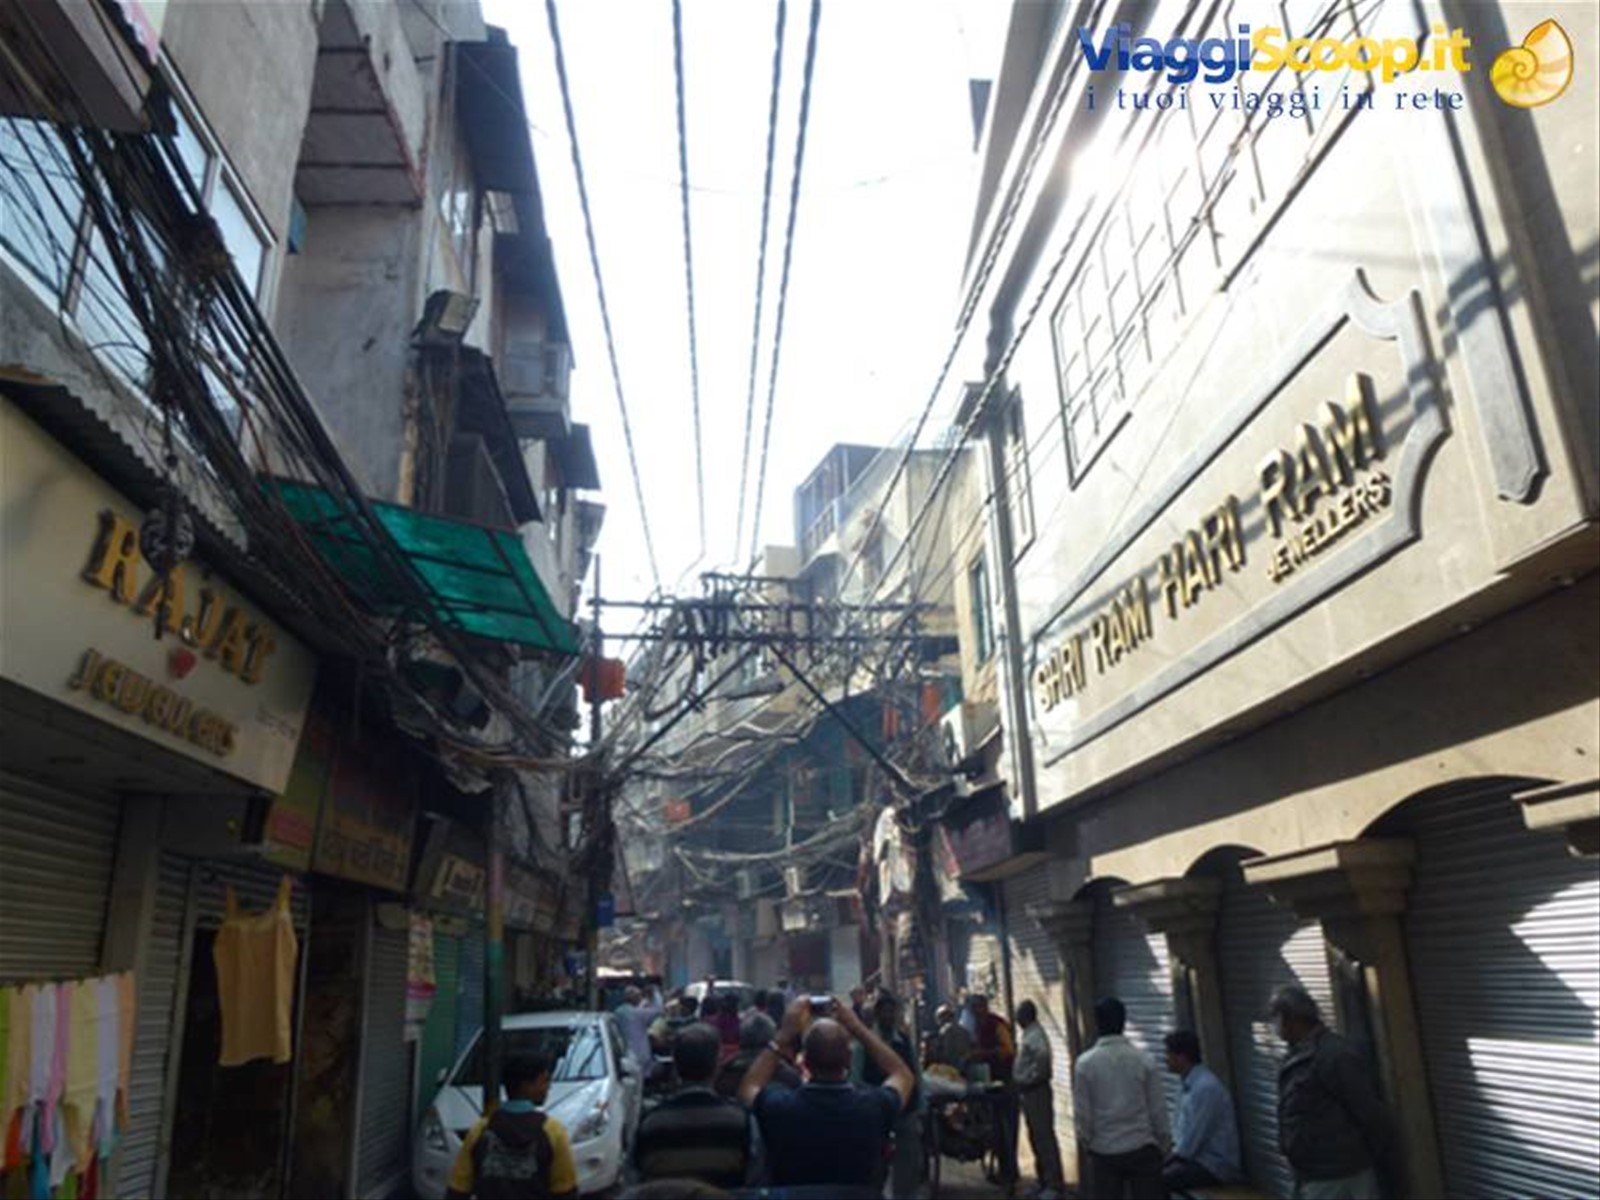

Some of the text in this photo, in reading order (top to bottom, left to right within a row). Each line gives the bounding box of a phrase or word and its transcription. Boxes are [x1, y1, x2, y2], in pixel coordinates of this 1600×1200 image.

[1034, 371, 1387, 712] SHRI RAM HARI RAM
